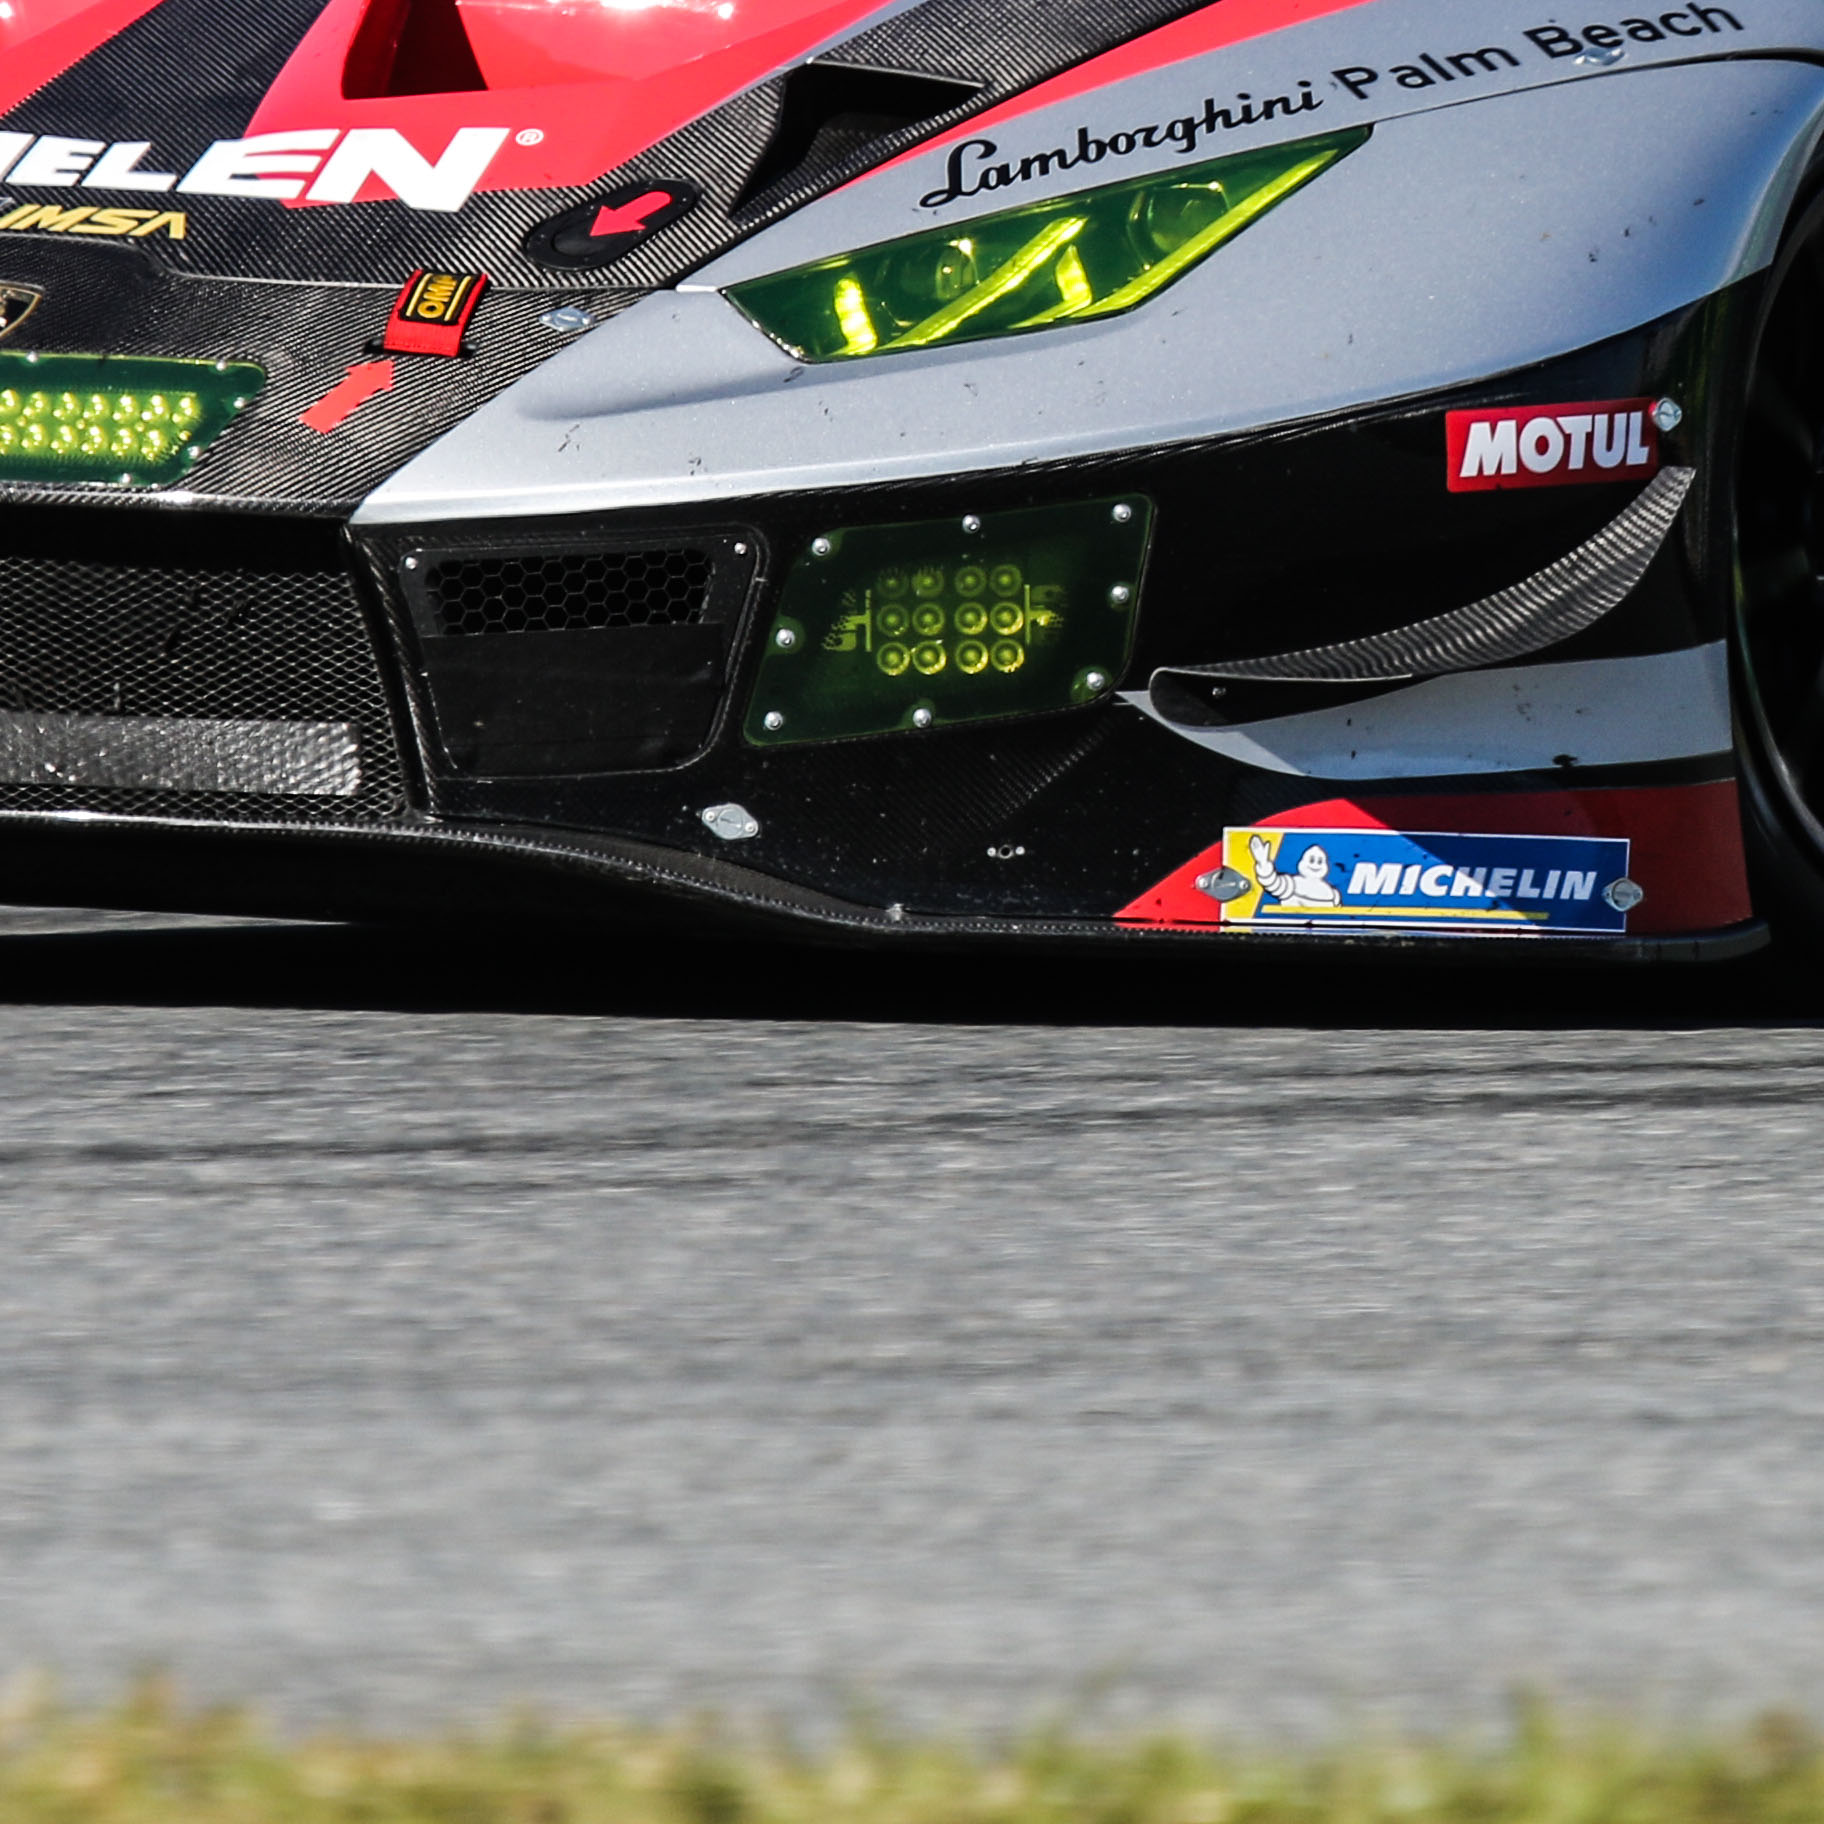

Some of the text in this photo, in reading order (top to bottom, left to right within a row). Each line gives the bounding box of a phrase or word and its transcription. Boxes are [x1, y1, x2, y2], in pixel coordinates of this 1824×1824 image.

[919, 0, 1745, 208] Lamborghini Palm Beach
[1460, 411, 1649, 479] MOTUL
[1348, 862, 1598, 901] MICHELIN
